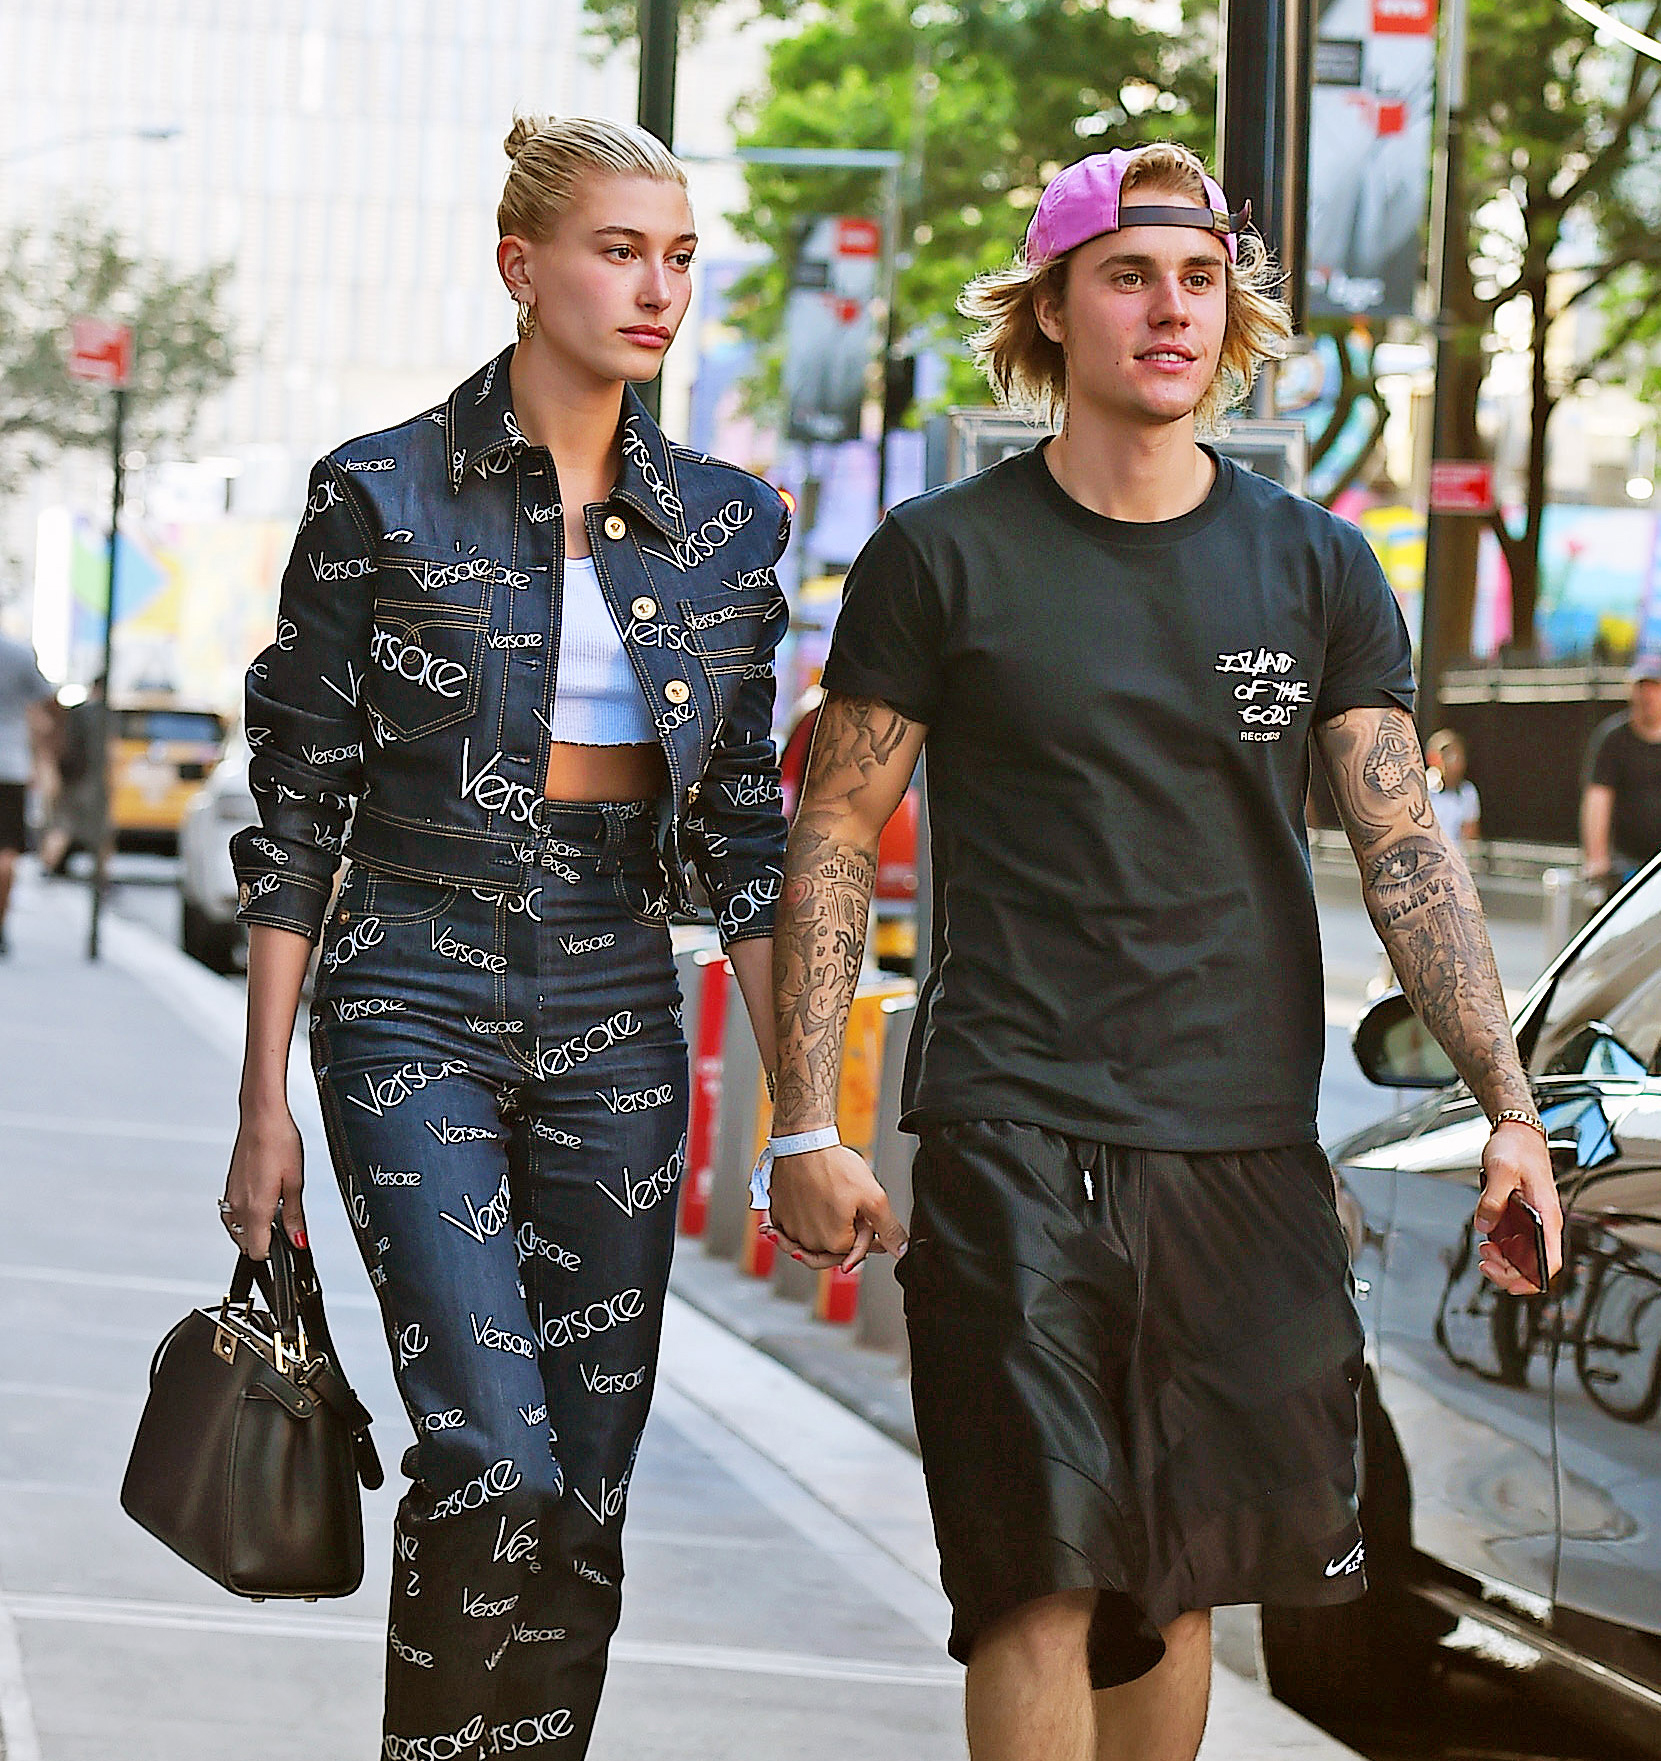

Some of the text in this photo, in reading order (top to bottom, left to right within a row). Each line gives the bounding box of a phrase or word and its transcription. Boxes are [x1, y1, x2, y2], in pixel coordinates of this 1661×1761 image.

[336, 459, 395, 472] Versace
[642, 500, 753, 573] Versace
[486, 629, 542, 649] Versace
[1215, 647, 1297, 677] ISLAND
[1234, 680, 1312, 702] OF THE
[1237, 705, 1297, 725] GODS
[430, 919, 507, 974] Versace
[559, 931, 616, 956] Versace
[464, 1015, 524, 1034] Versace
[530, 1010, 642, 1083] Versace
[595, 1082, 675, 1115] Versace
[368, 1164, 422, 1186] Versace
[534, 1288, 645, 1353] Versace
[469, 1312, 534, 1360] Versace
[511, 1621, 567, 1643] Versace
